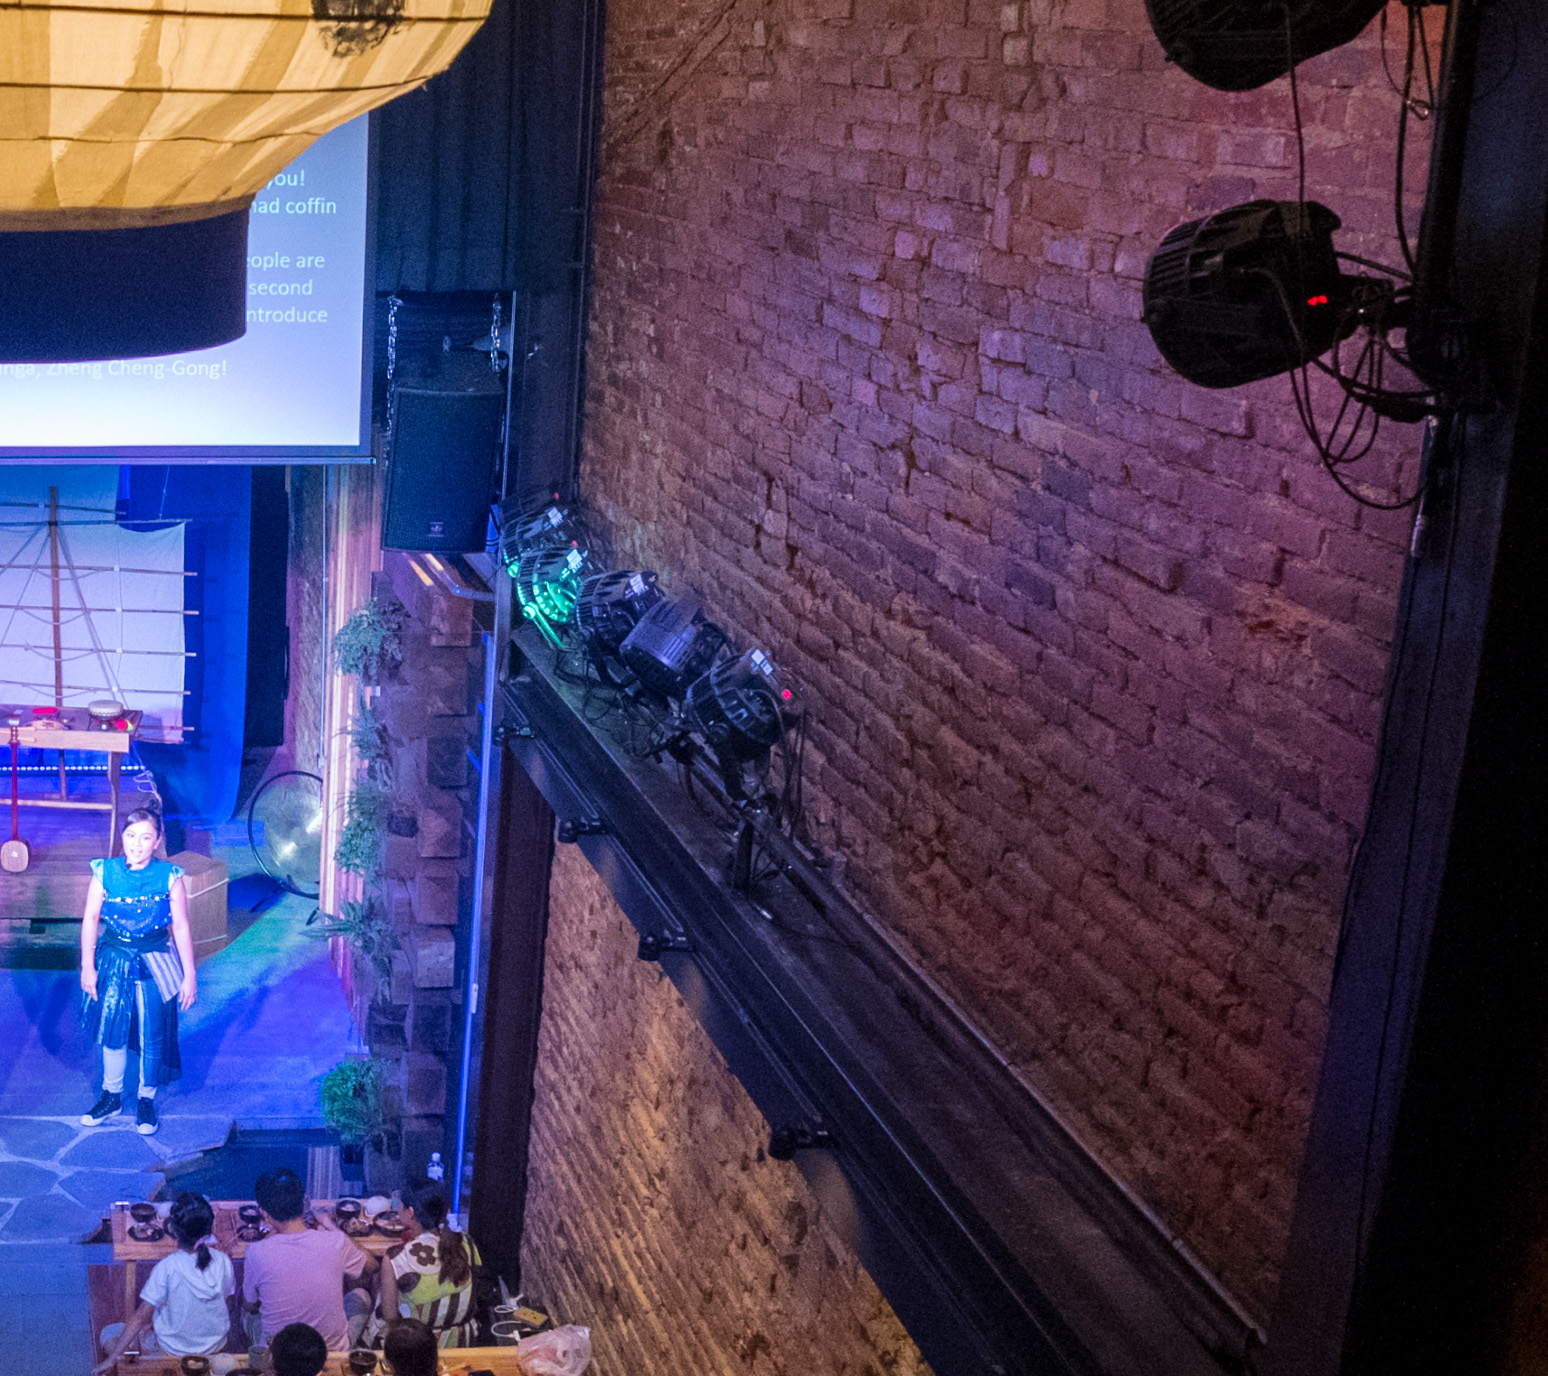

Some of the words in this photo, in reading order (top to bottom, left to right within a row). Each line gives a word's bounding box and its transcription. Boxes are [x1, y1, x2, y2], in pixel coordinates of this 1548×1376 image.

[286, 197, 336, 214] coffin
[247, 251, 291, 271] ople
[296, 256, 325, 268] are
[248, 279, 313, 296] second
[246, 306, 328, 323] ntroduce
[108, 359, 227, 380] Cheng-Gong!
